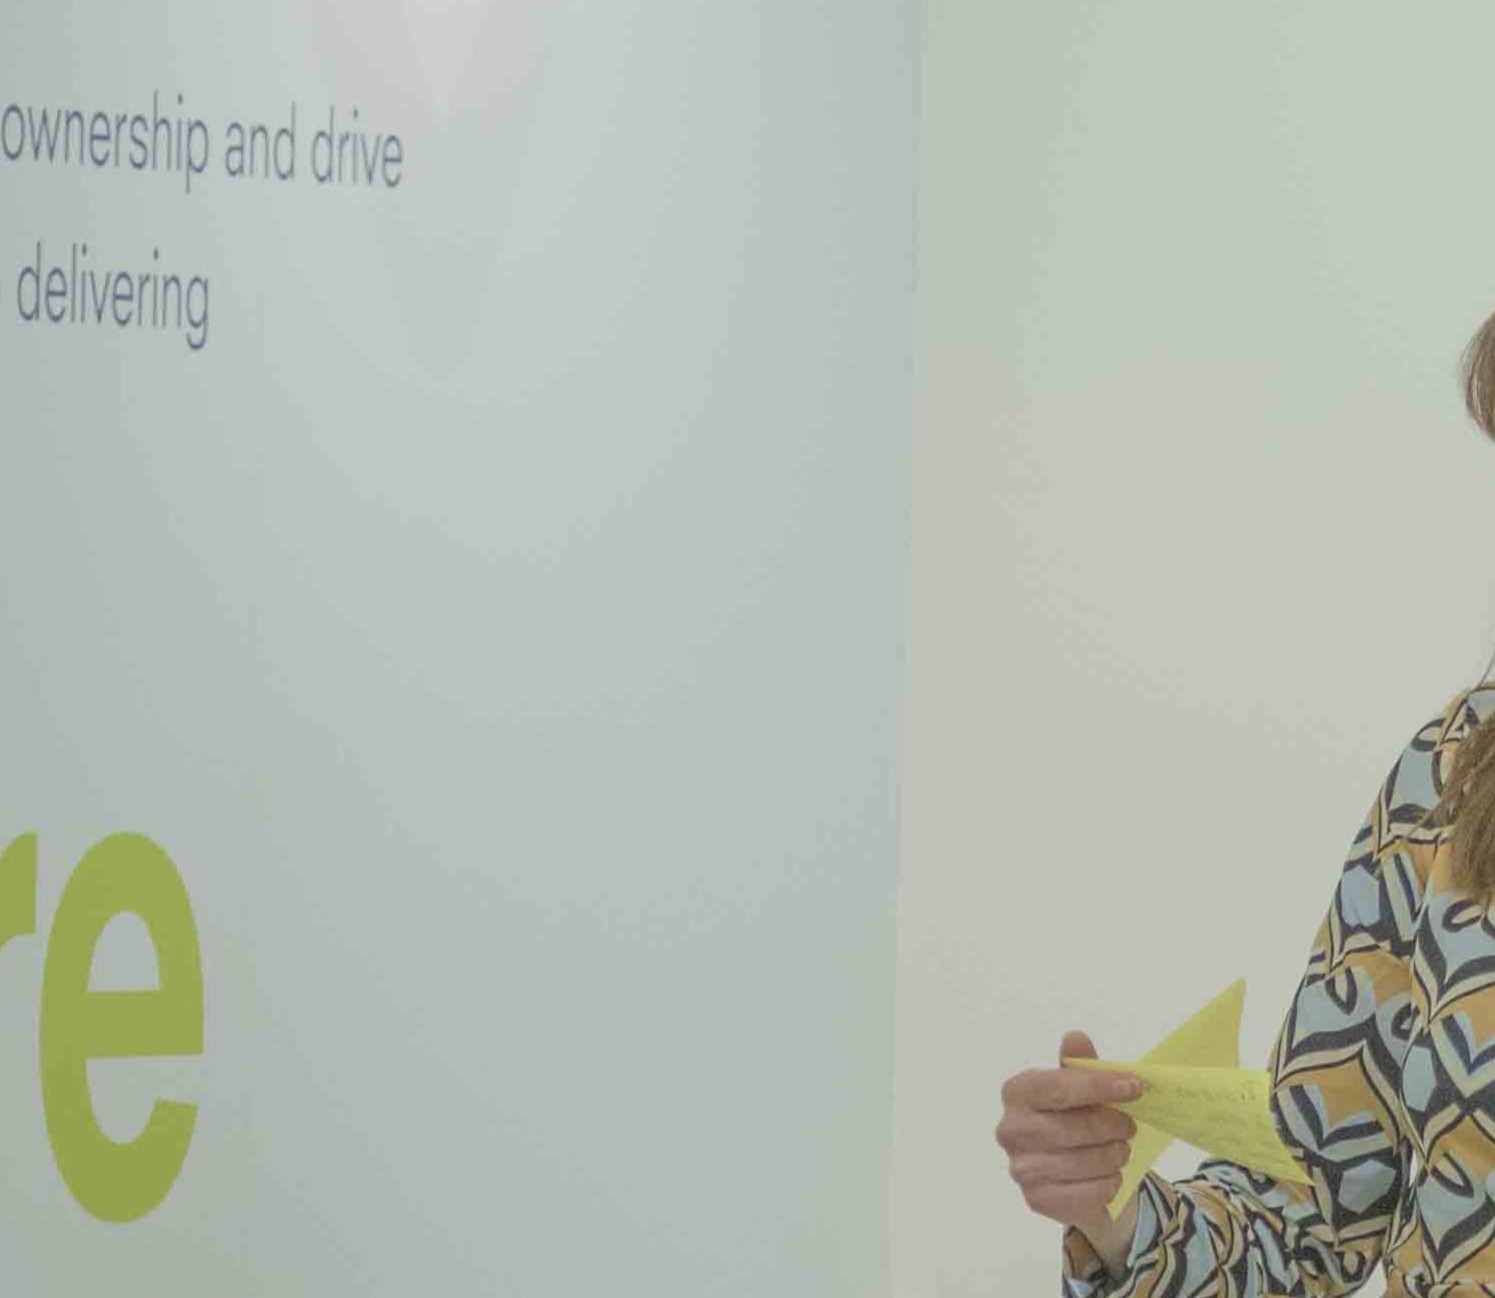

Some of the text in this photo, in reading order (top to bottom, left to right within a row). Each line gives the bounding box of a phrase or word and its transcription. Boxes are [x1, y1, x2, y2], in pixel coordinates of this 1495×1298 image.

[2, 91, 211, 194] ownership
[224, 103, 298, 182] and
[310, 108, 404, 190] drive
[17, 241, 211, 351] delivering
